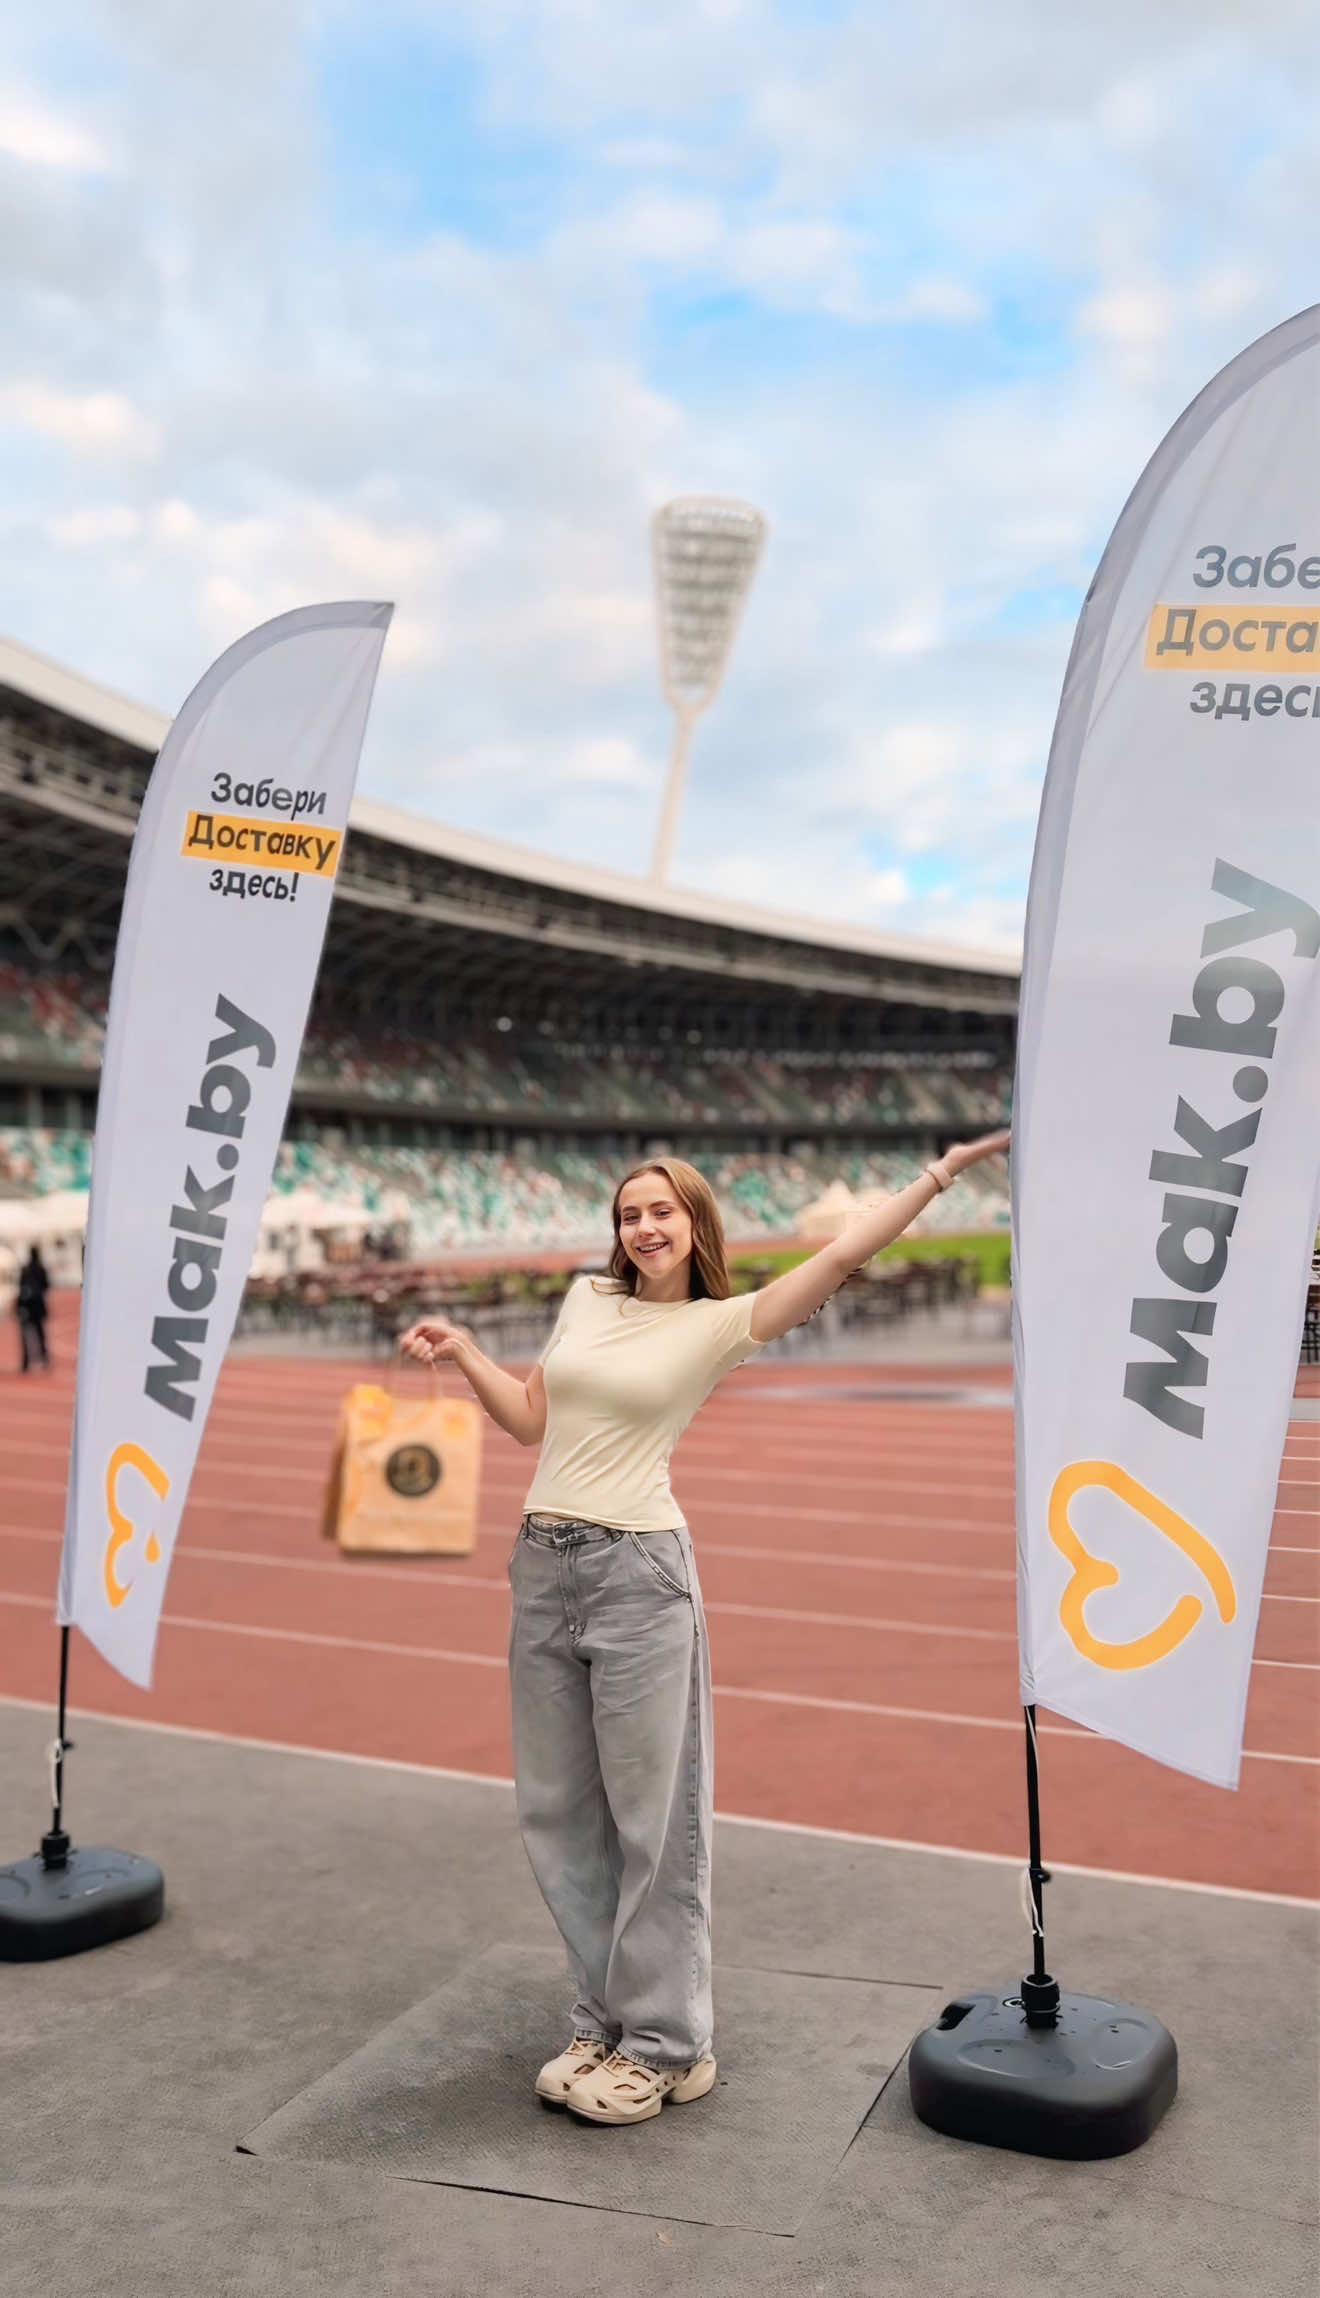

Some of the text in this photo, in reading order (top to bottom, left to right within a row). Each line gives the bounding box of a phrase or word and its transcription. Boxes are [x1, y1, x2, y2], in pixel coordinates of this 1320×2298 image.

[211, 772, 327, 821] Забери
[188, 814, 336, 870] Доставку
[209, 869, 300, 902] здесь!
[1123, 857, 1320, 1439] Mak.by
[144, 993, 277, 1423] Mak.by
